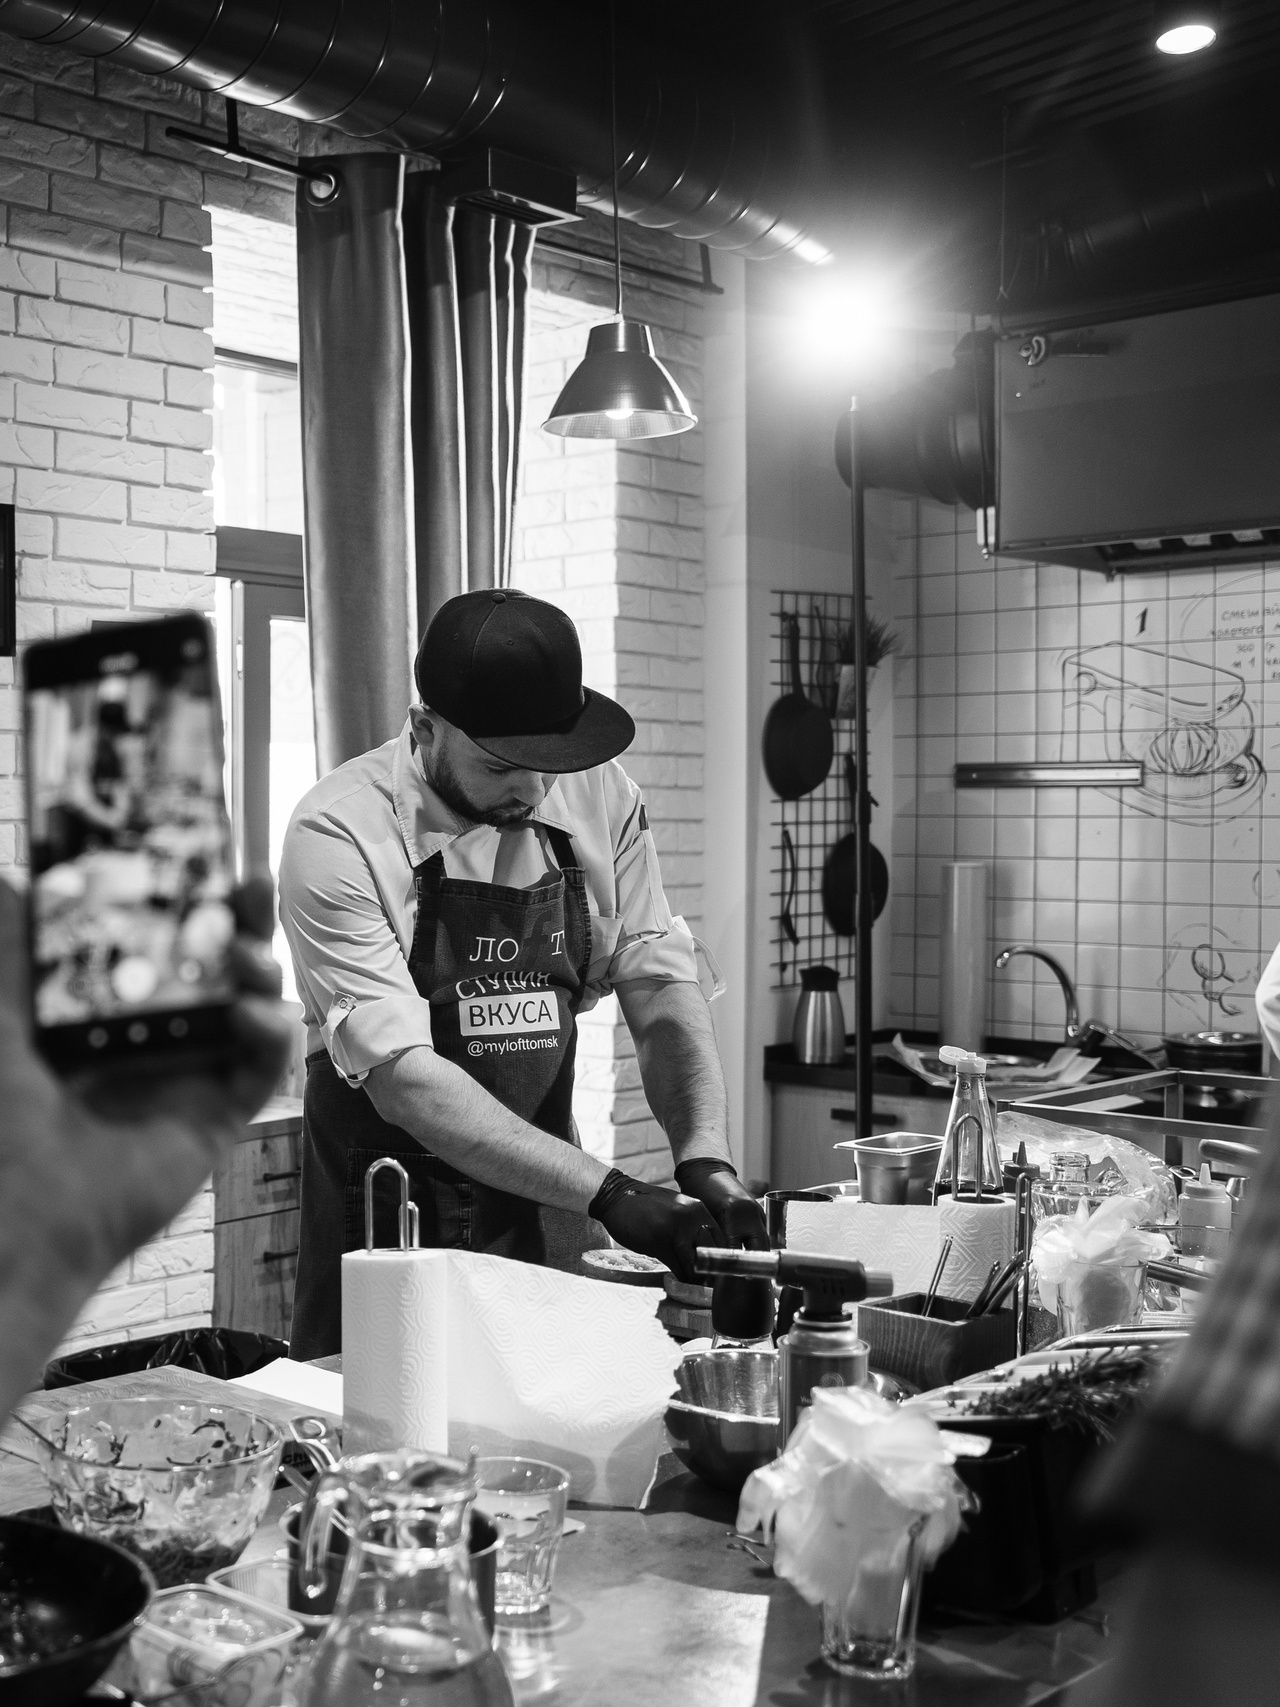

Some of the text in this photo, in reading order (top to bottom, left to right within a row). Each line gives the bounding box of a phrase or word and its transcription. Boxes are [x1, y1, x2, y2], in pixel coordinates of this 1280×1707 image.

[1136, 608, 1148, 636] 1
[455, 971, 551, 1000] СТУДИЯ
[469, 1000, 552, 1027] ВКУСА
[467, 1035, 558, 1056] @mylofttomsk
